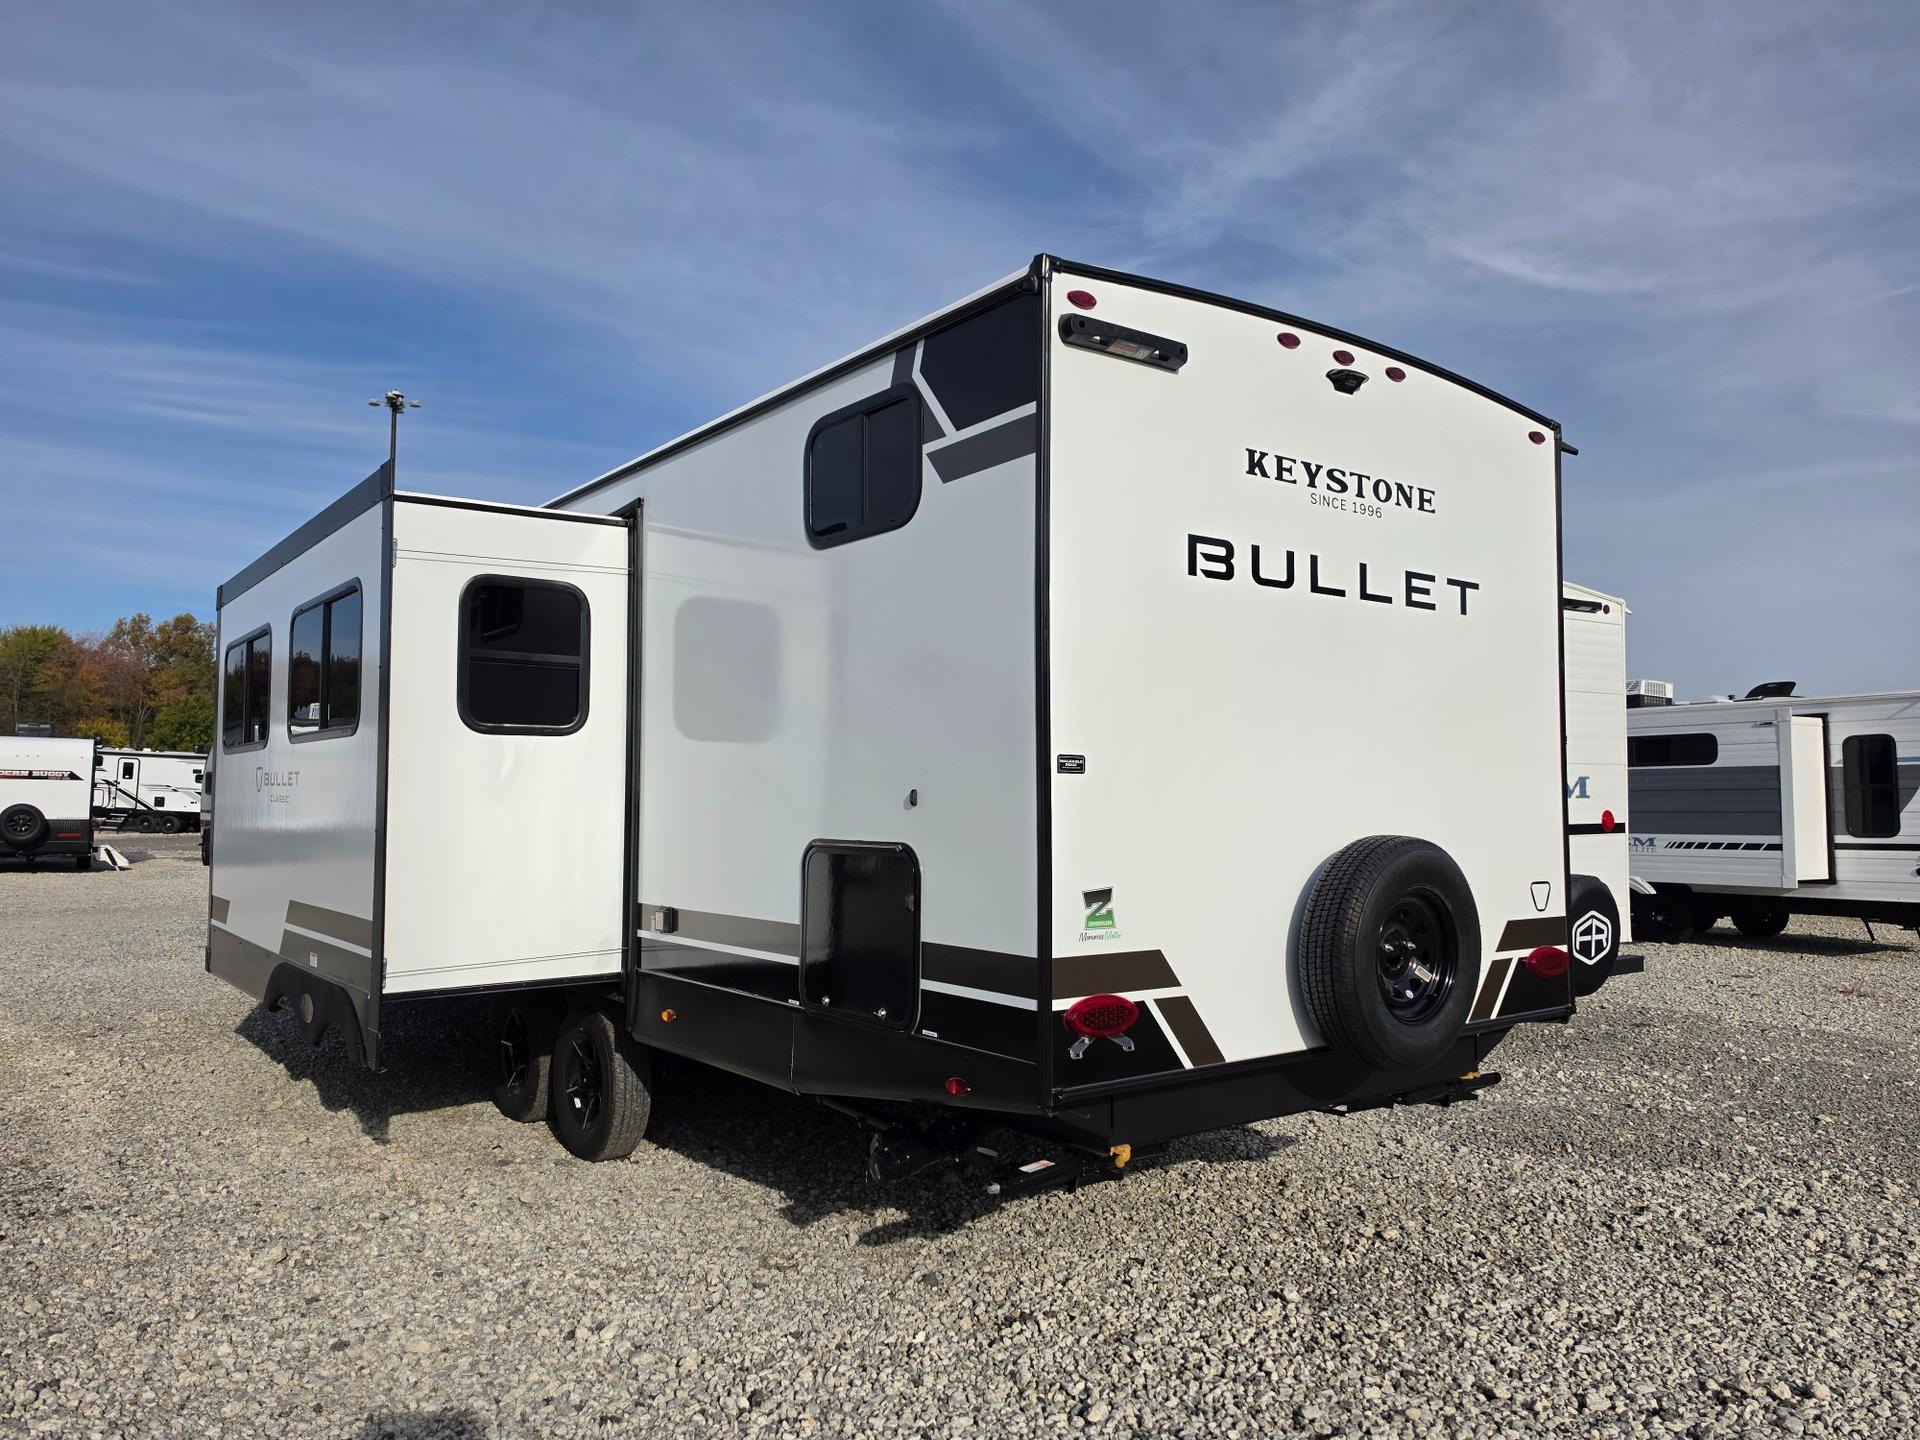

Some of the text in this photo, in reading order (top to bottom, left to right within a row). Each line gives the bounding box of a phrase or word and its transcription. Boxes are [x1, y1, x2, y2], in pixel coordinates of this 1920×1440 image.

[1246, 448, 1436, 514] KEYSTONE
[1310, 492, 1383, 519] SINCE 1996
[1188, 533, 1480, 616] BULLET
[264, 771, 300, 786] BULLET
